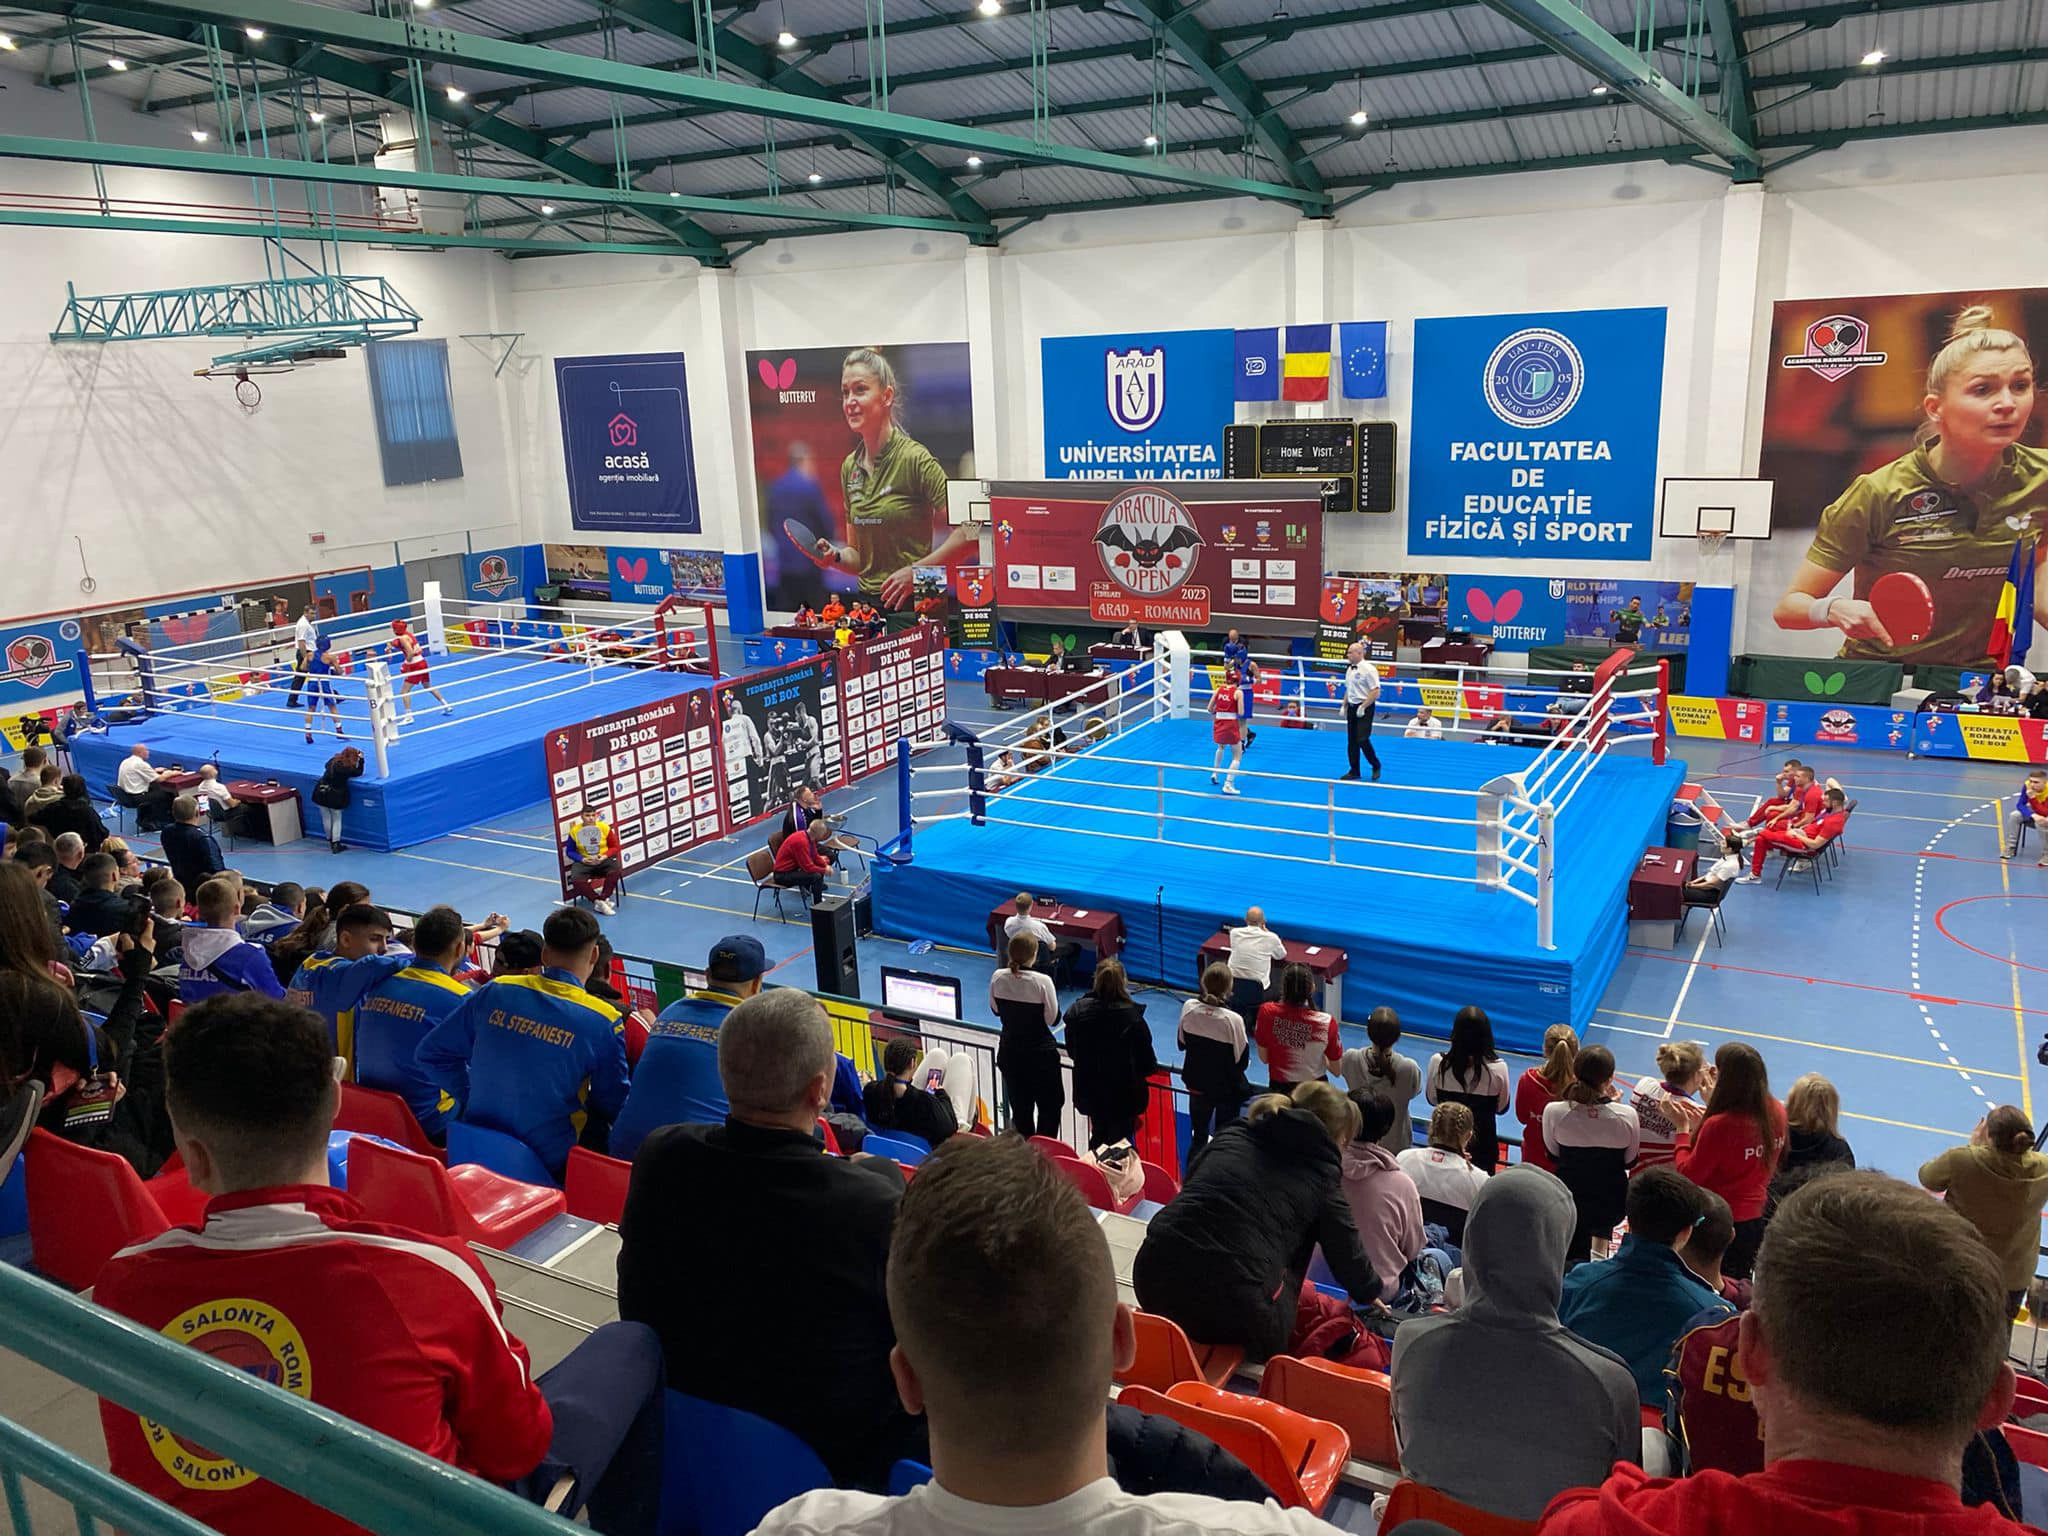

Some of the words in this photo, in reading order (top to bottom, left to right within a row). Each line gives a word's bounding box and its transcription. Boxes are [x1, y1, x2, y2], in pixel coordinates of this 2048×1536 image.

[1508, 342, 1529, 359] UAV
[1537, 341, 1561, 358] FEFS
[1116, 358, 1155, 368] ARAD
[1495, 375, 1509, 385] 20
[1558, 373, 1572, 383] 05
[779, 391, 816, 403] BUTTERFLY
[1501, 397, 1522, 414] ARAD
[1450, 440, 1612, 461] FACULTATEA
[605, 451, 649, 469] acasă
[1511, 468, 1545, 488] DE
[1115, 495, 1178, 524] DRACULA
[1545, 522, 1633, 543] SPORT
[634, 584, 664, 595] BUTTERFLY
[1126, 569, 1171, 592] OPEN
[1589, 582, 1618, 592] TEAM
[1181, 589, 1206, 600] 2023
[1098, 603, 1129, 617] ARAD
[1144, 605, 1202, 621] ROMANIA
[1492, 625, 1547, 641] BUTTERFLY
[880, 654, 893, 666] DE
[893, 648, 911, 663] BOX
[763, 694, 777, 708] DE
[779, 686, 801, 703] BOX
[1218, 693, 1230, 701] POL
[586, 718, 636, 739] FEDERAȚIA
[609, 737, 628, 751] DE
[630, 725, 659, 746] BOX
[1536, 835, 1547, 848] A
[489, 1009, 506, 1027] CSL
[507, 1015, 575, 1049] STEFANESTI
[182, 1307, 276, 1335] SALONTA
[173, 1456, 246, 1482] SALONT
